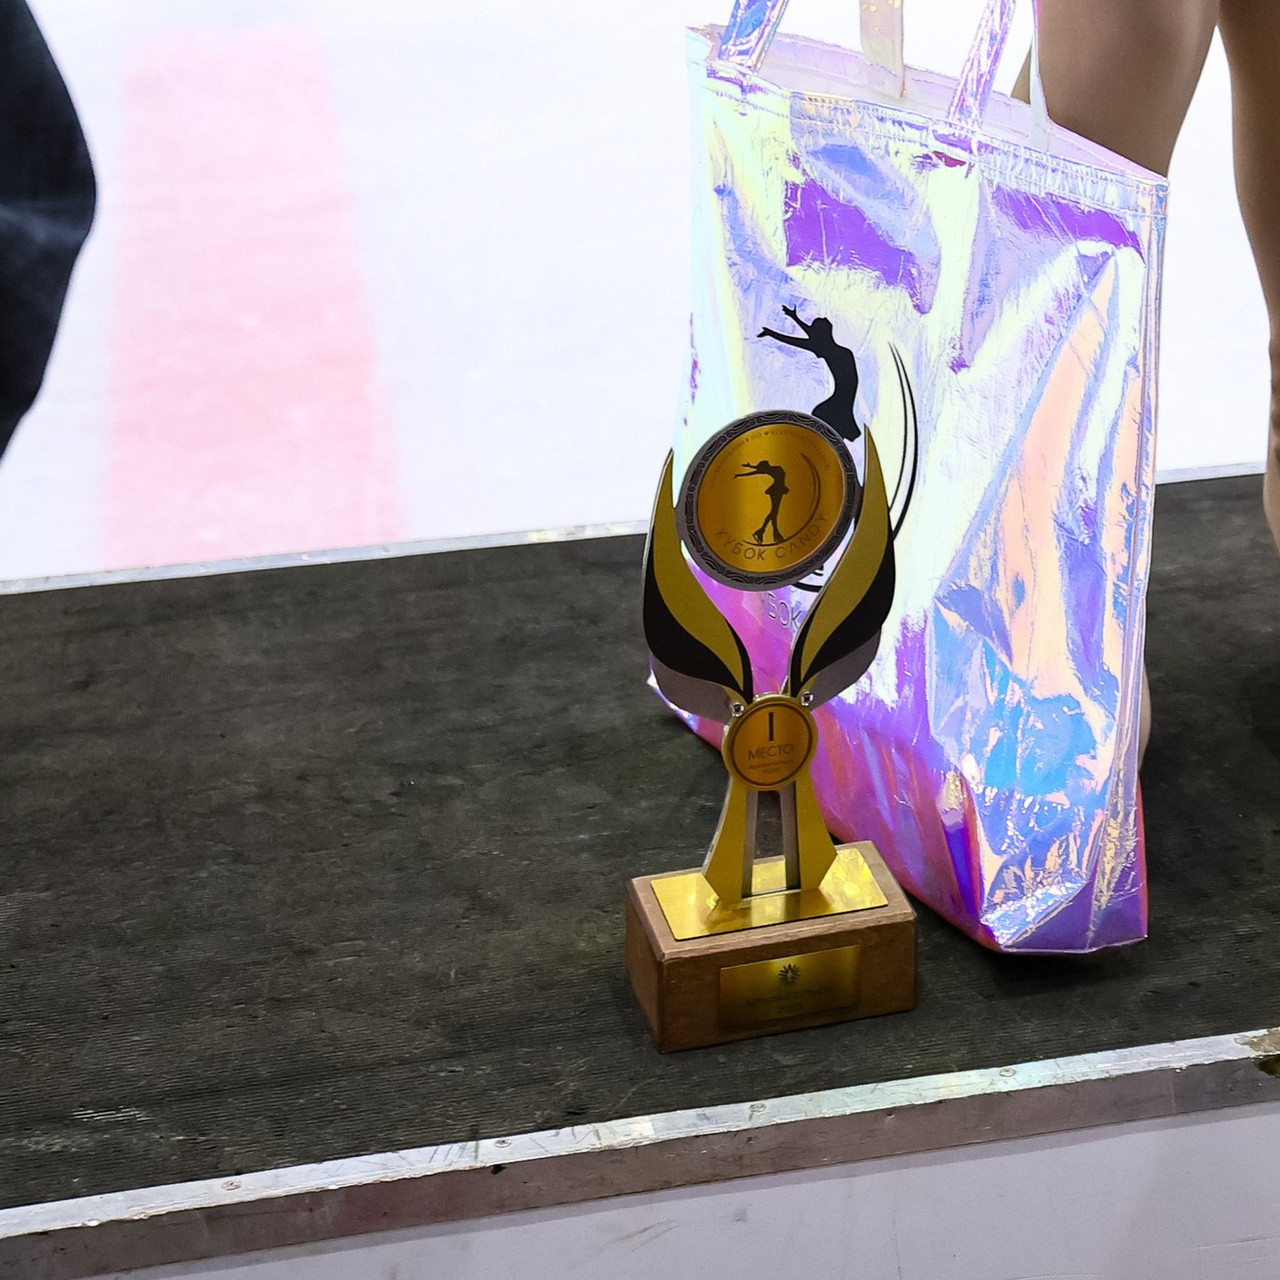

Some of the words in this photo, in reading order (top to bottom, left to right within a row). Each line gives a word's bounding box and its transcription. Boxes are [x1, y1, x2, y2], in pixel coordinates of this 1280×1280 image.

[716, 527, 766, 561] КУБОК
[774, 516, 827, 559] CANDY
[748, 743, 794, 760] МЕСТО
